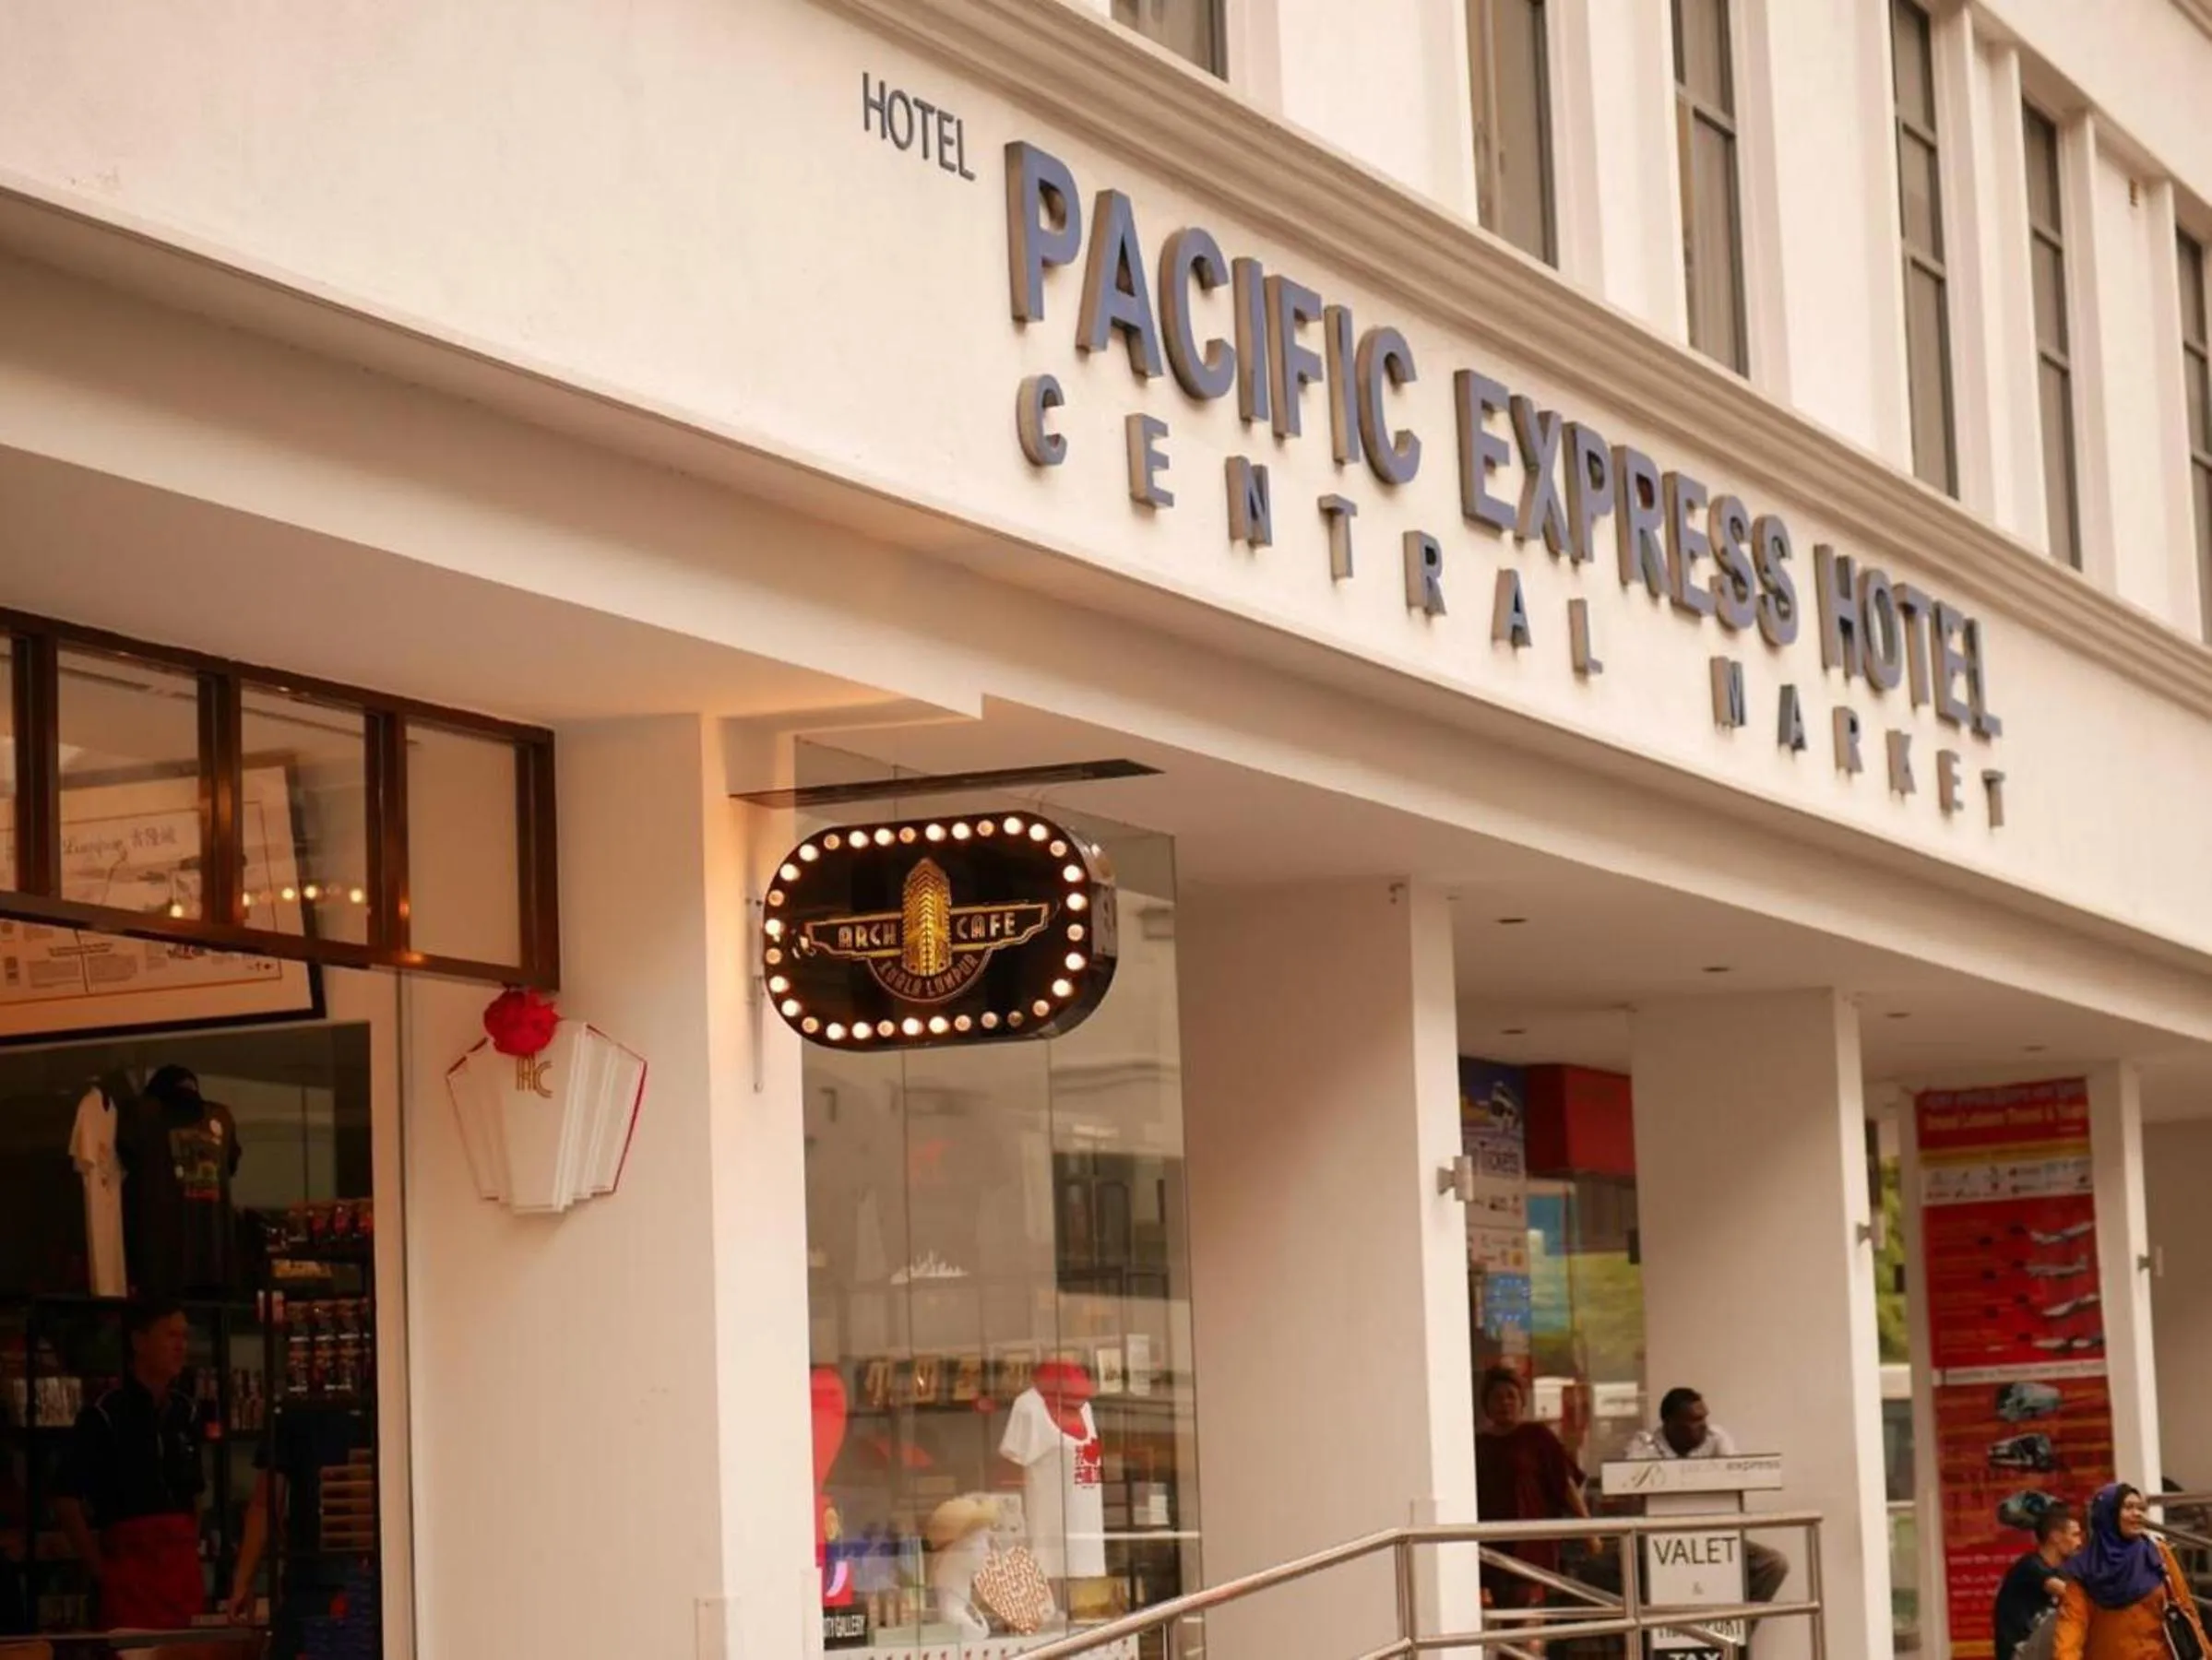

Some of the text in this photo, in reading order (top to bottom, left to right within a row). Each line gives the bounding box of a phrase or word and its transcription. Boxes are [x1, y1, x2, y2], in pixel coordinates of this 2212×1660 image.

[862, 72, 975, 182] HOTEL
[1005, 139, 2003, 737] PACIFIC EXPRESS HOTEL
[1016, 374, 2005, 828] CENTRAL MARKET
[838, 911, 1016, 948] ARCH CAFE
[1653, 1536, 1738, 1566] VALET
